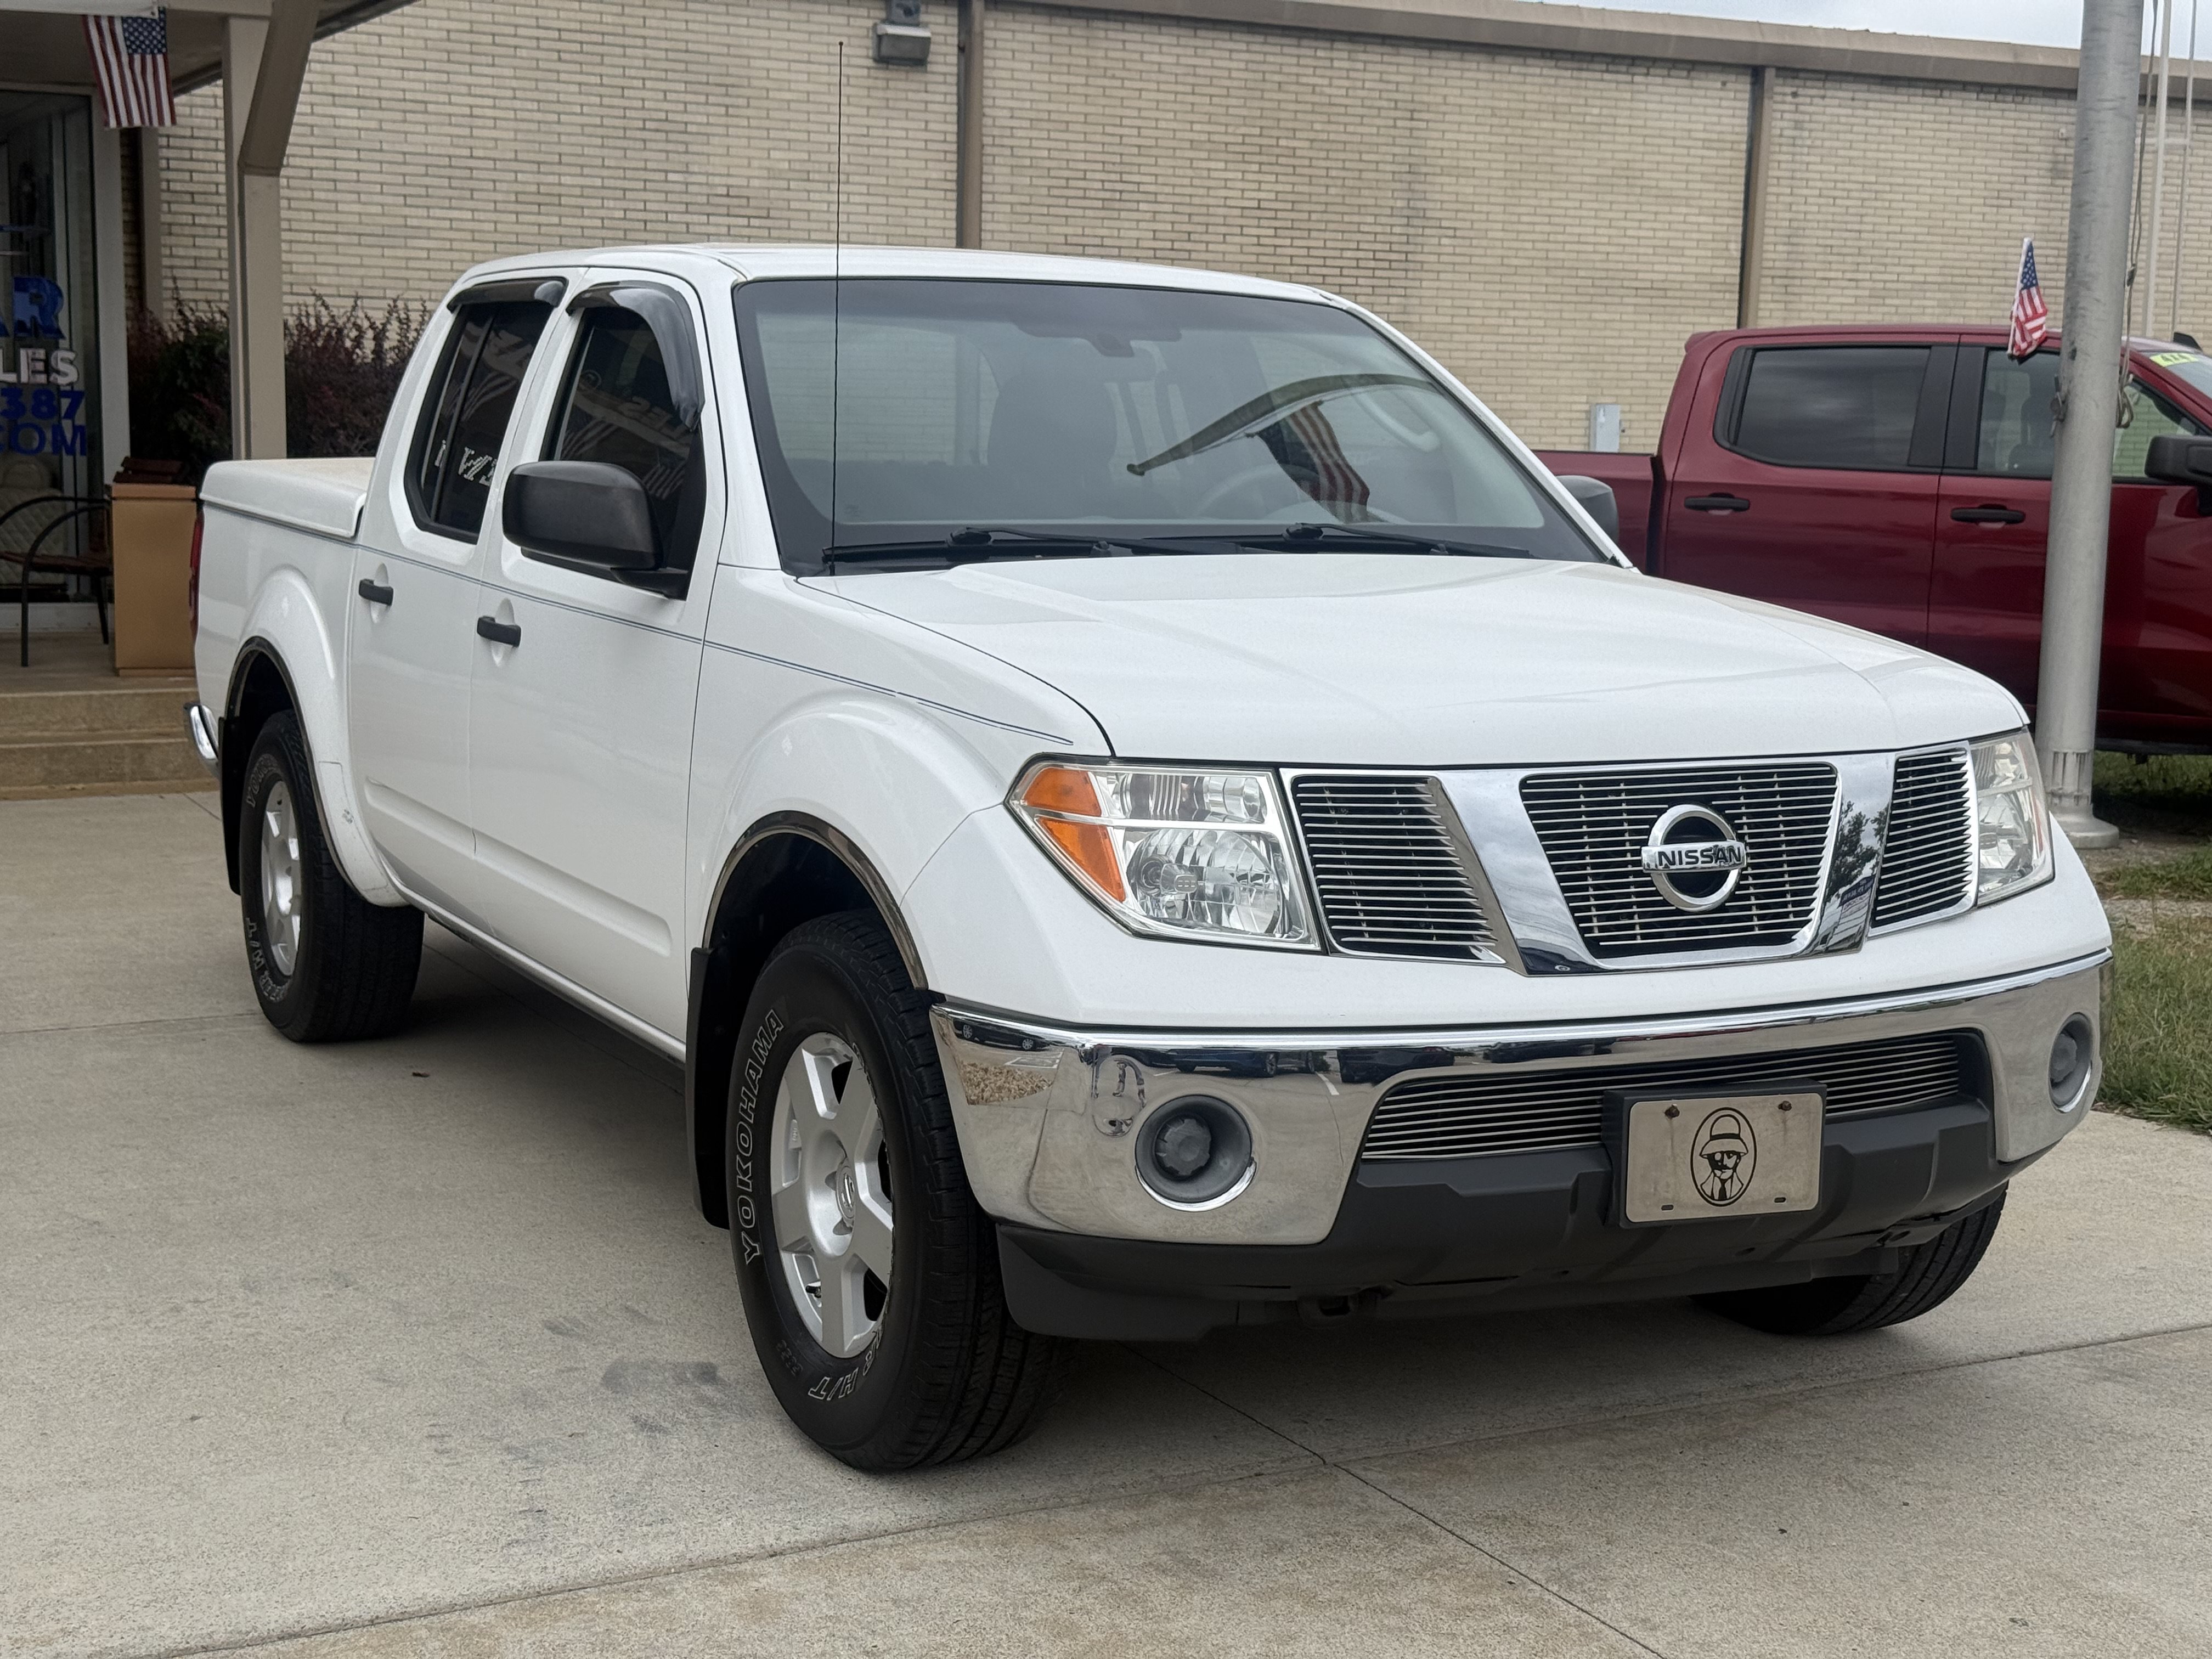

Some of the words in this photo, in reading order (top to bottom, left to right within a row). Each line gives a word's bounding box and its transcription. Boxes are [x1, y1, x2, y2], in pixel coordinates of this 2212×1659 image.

[0, 276, 66, 340] R
[0, 422, 87, 456] OM
[1657, 845, 1741, 867] NISSAN
[736, 1009, 785, 1264] YOKOHAMA
